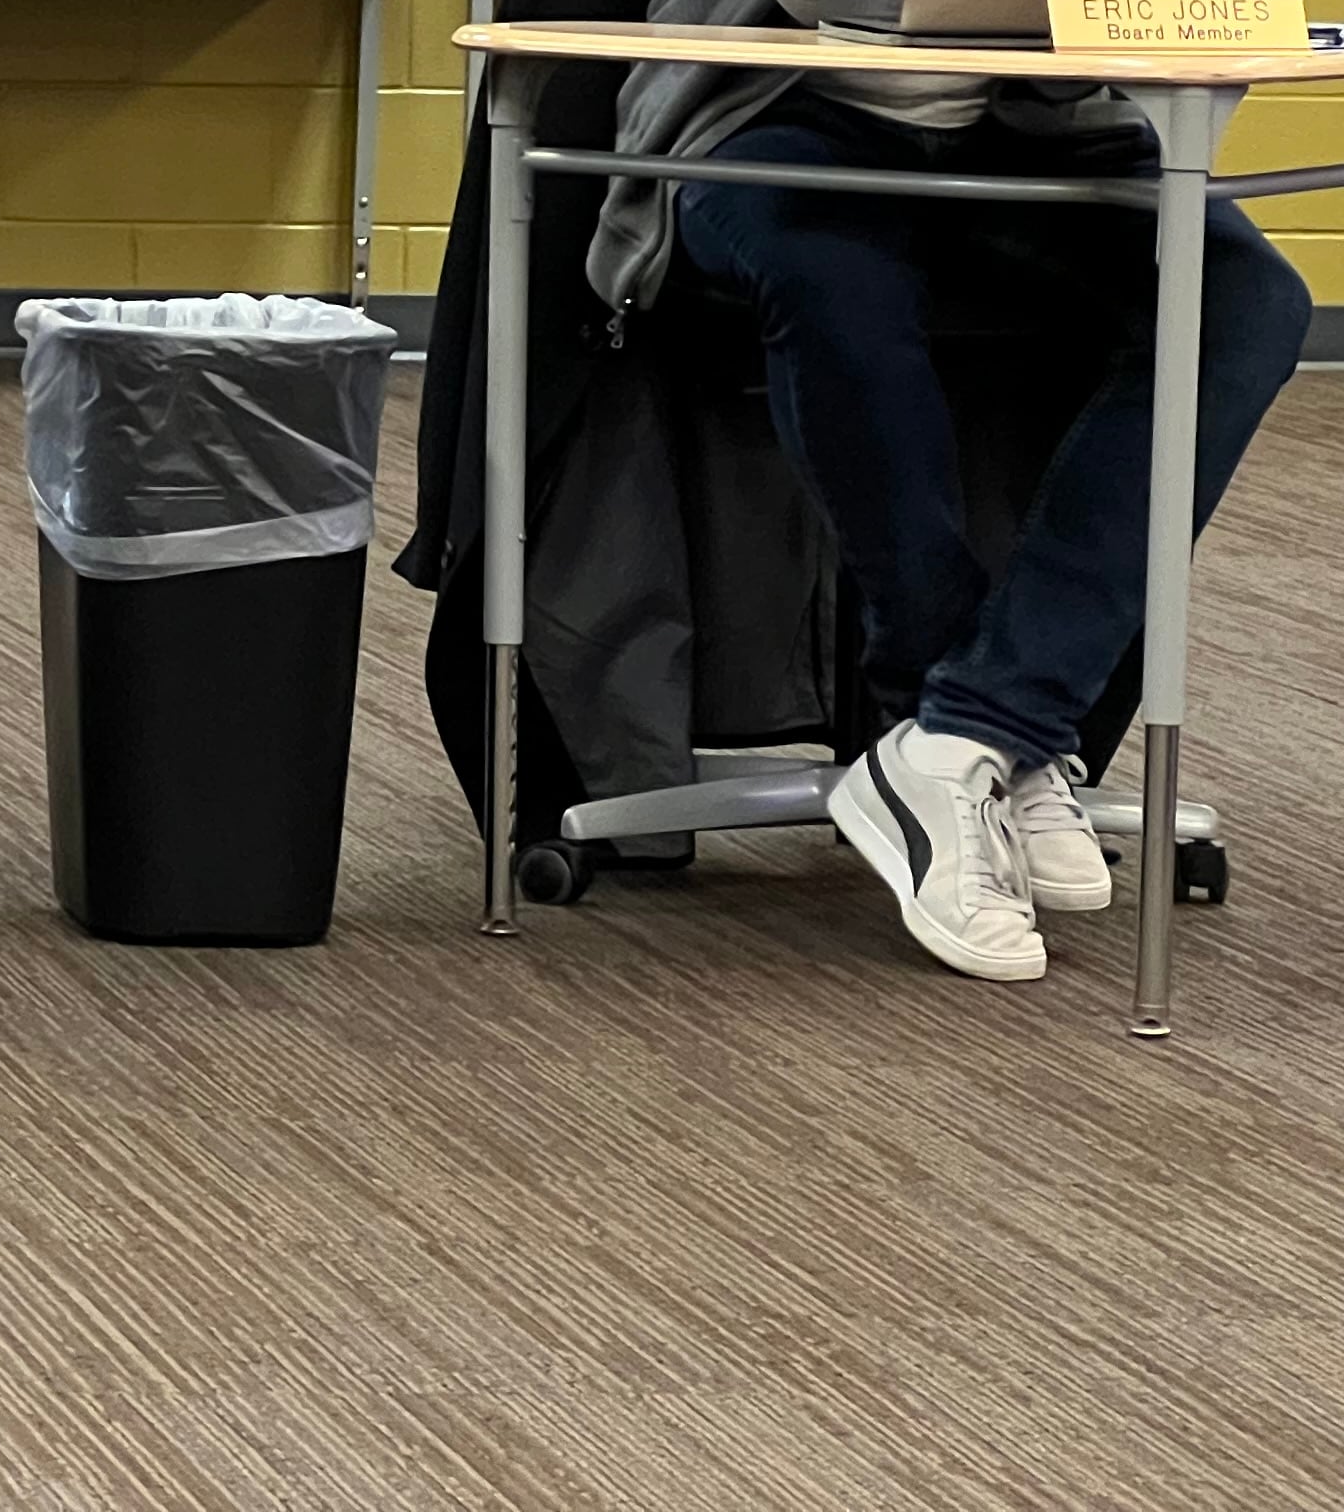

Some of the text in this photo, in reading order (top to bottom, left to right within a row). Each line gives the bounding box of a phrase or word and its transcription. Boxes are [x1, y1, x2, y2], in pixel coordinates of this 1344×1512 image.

[1083, 0, 1270, 22] ERIC JONES
[1107, 24, 1253, 41] Board Member
